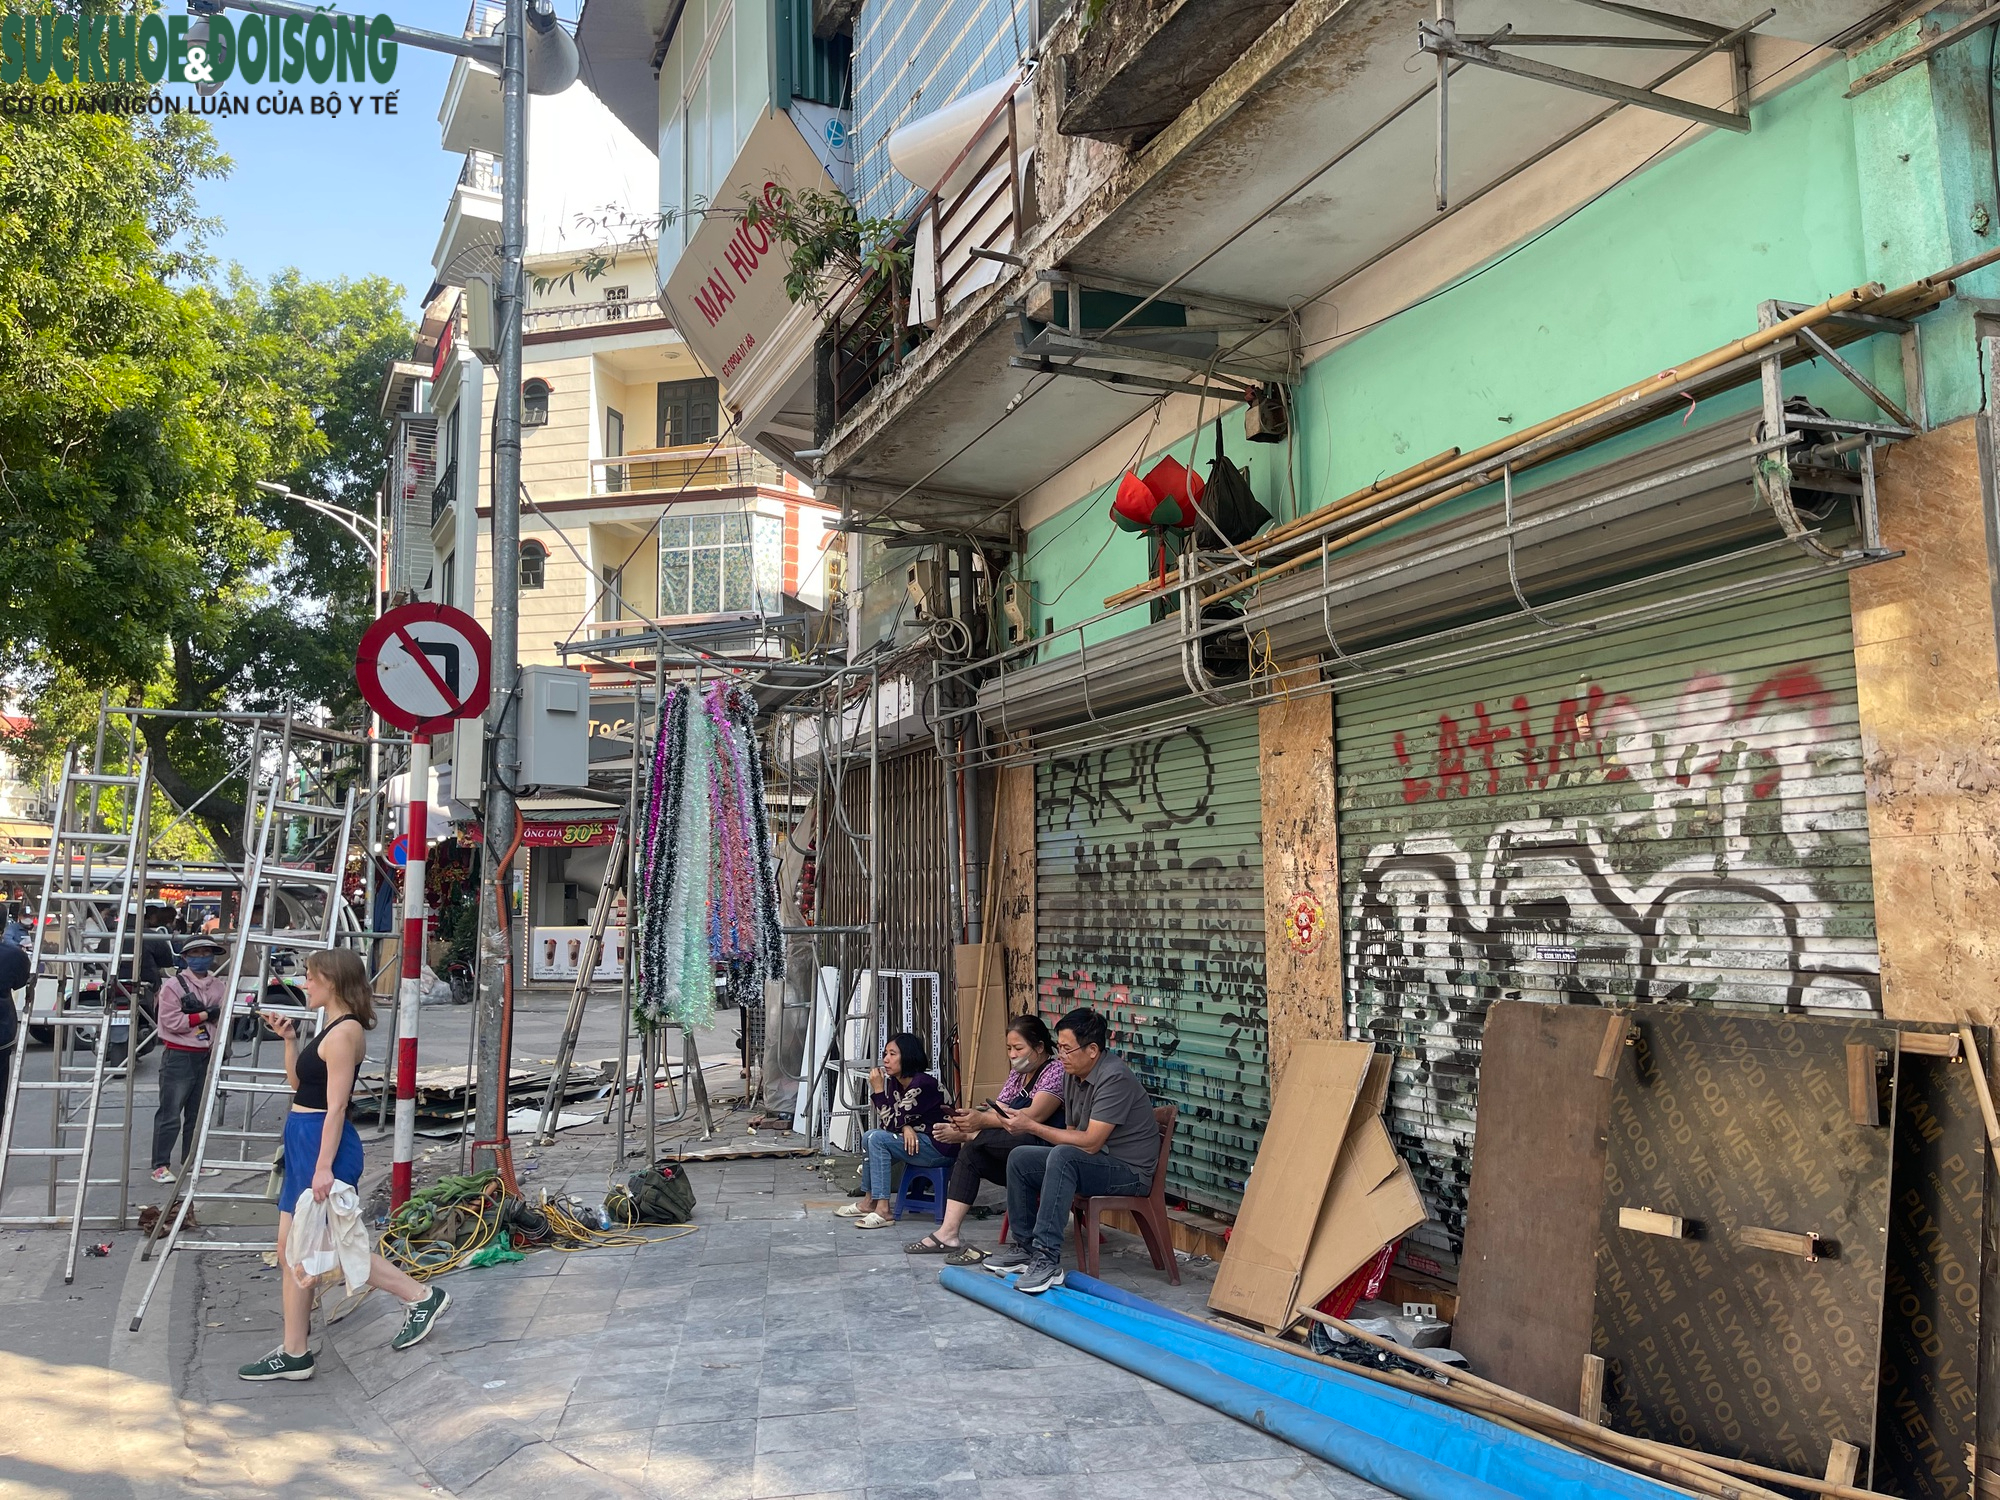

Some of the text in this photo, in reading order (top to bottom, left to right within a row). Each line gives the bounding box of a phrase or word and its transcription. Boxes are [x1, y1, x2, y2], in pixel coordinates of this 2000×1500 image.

[1654, 1026, 1677, 1068] PREMIUM
[1676, 1070, 1691, 1092] FILM
[1690, 1095, 1709, 1127] FACED
[1709, 1131, 1738, 1180] PLYWOOD
[1929, 1067, 1949, 1093] VIET
[1622, 1148, 1640, 1181] FACED
[1643, 1098, 1657, 1120] FILM
[1656, 1123, 1674, 1155] FACED
[1673, 1159, 1701, 1207] PLYWOOD
[1724, 1117, 1789, 1227] VIETNAM
[1726, 1067, 1746, 1099] FACED
[1745, 1102, 1776, 1152] PLYWOOD
[1791, 1184, 1808, 1209] NAM
[1762, 1088, 1831, 1198] VIETNAM
[1928, 1171, 1964, 1224] PREMIUM
[1733, 1275, 1762, 1327] PREMIUM
[1777, 1363, 1800, 1403] FACED
[1745, 1262, 1821, 1394] PLYWOOD
[1917, 1260, 1938, 1290] FILM
[1937, 1294, 1964, 1335] FACED
[1627, 1349, 1653, 1398] PREMIUM
[1661, 1325, 1688, 1376] PREMIUM
[1686, 1380, 1702, 1407] FILM
[1672, 1311, 1741, 1441] PLYWOOD
[1697, 1301, 1724, 1353] PREMIUM
[1723, 1356, 1740, 1384] FILM
[1738, 1388, 1761, 1427] FACED
[1707, 1287, 1780, 1418] PLYWOOD
[1818, 1338, 1842, 1377] FACED
[1920, 1373, 1959, 1436] PLYWOOD
